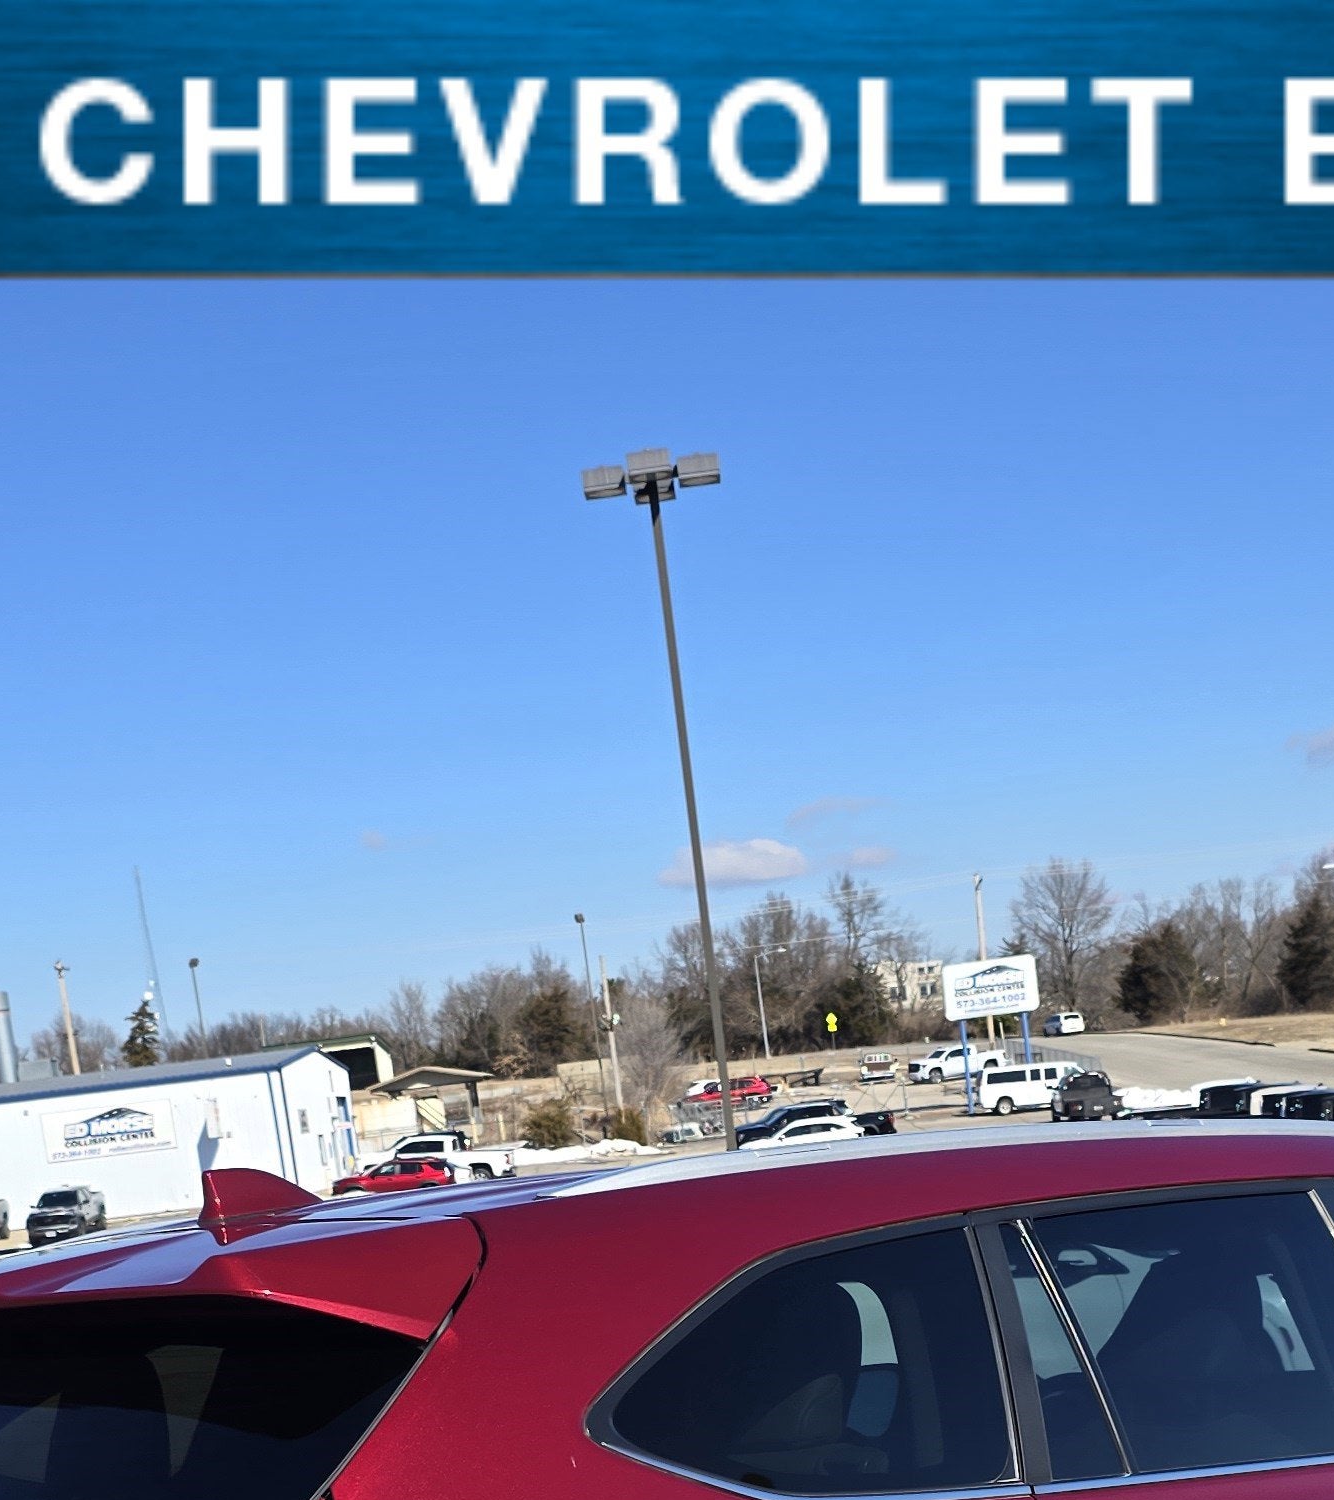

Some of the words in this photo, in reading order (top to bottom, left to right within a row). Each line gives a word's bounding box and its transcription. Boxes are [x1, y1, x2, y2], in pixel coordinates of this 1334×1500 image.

[956, 993, 1027, 1009] 573-364-1002
[64, 1122, 89, 1140] ED
[90, 1113, 154, 1137] MORSE
[64, 1135, 117, 1148] COLLISION
[120, 1129, 156, 1141] CENTER
